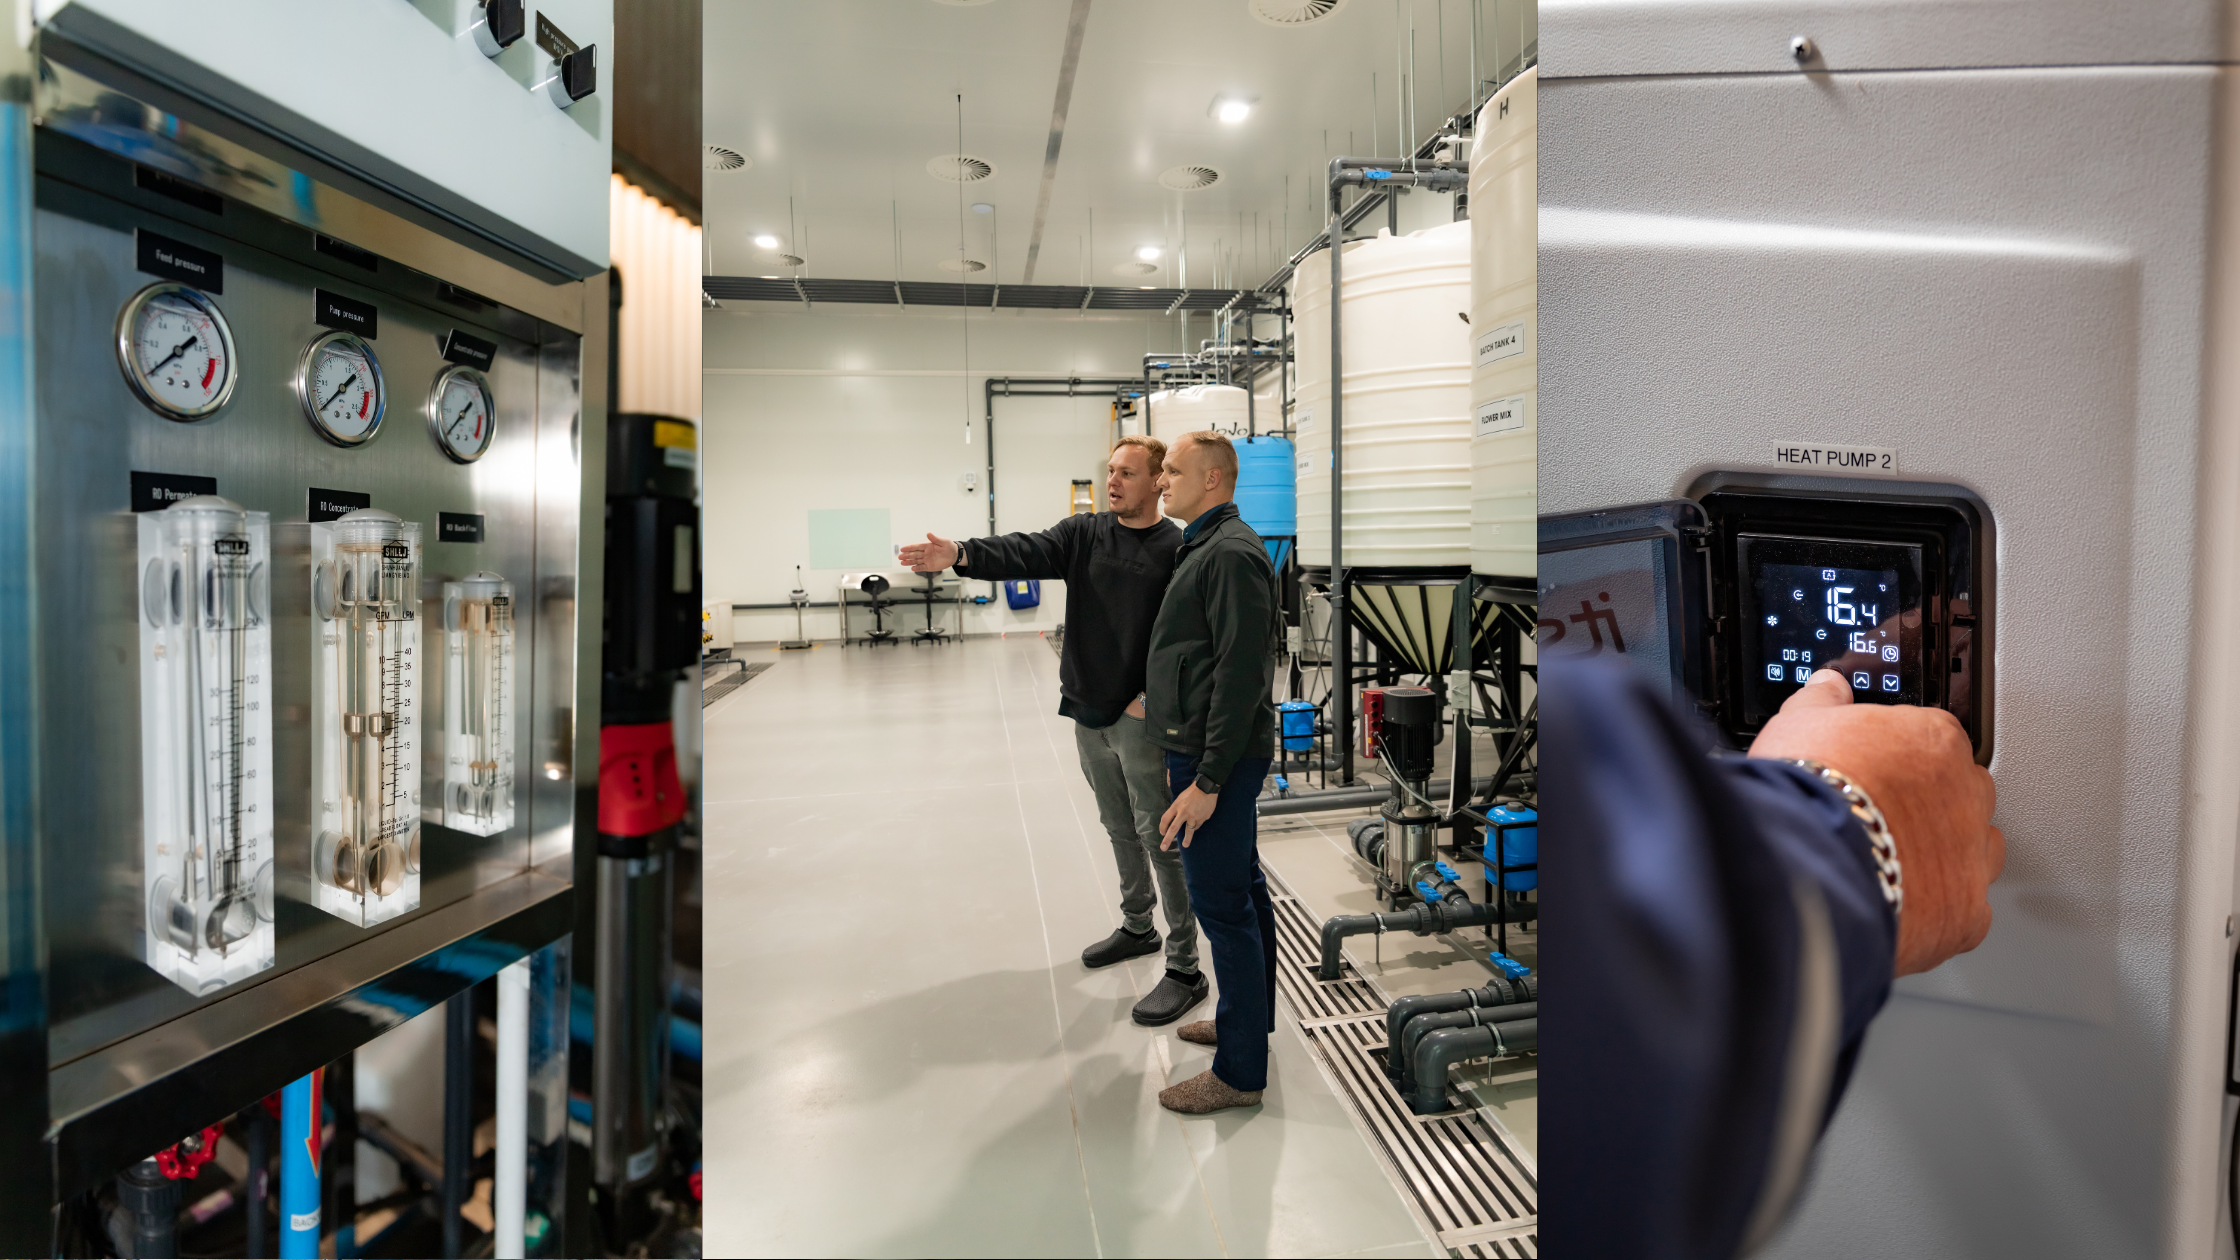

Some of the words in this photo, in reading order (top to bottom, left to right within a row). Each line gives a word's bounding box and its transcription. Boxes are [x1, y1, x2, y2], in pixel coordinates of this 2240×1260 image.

[156, 249, 173, 264] Feed
[174, 258, 205, 274] pressure
[329, 304, 341, 317] Pump
[343, 309, 364, 323] pressure
[1494, 336, 1510, 350] TANK
[1511, 335, 1516, 343] 4
[1482, 413, 1498, 424] FLOWER
[1500, 410, 1512, 420] MIX
[1777, 448, 1822, 464] HEAT
[1827, 450, 1876, 468] PUMP
[1882, 454, 1891, 469] 2
[152, 487, 162, 500] RO
[385, 547, 407, 557] SHLLJ
[1826, 586, 1877, 626] 16.4
[376, 612, 390, 620] GPM
[1849, 632, 1877, 654] 16.6
[246, 675, 259, 684] 120
[1798, 668, 1809, 681] M
[246, 702, 259, 711] 100
[404, 717, 411, 725] 20
[404, 742, 411, 750] 15
[404, 763, 411, 771] 10
[248, 803, 257, 813] 40
[248, 838, 257, 848] 20
[248, 852, 257, 862] 10
